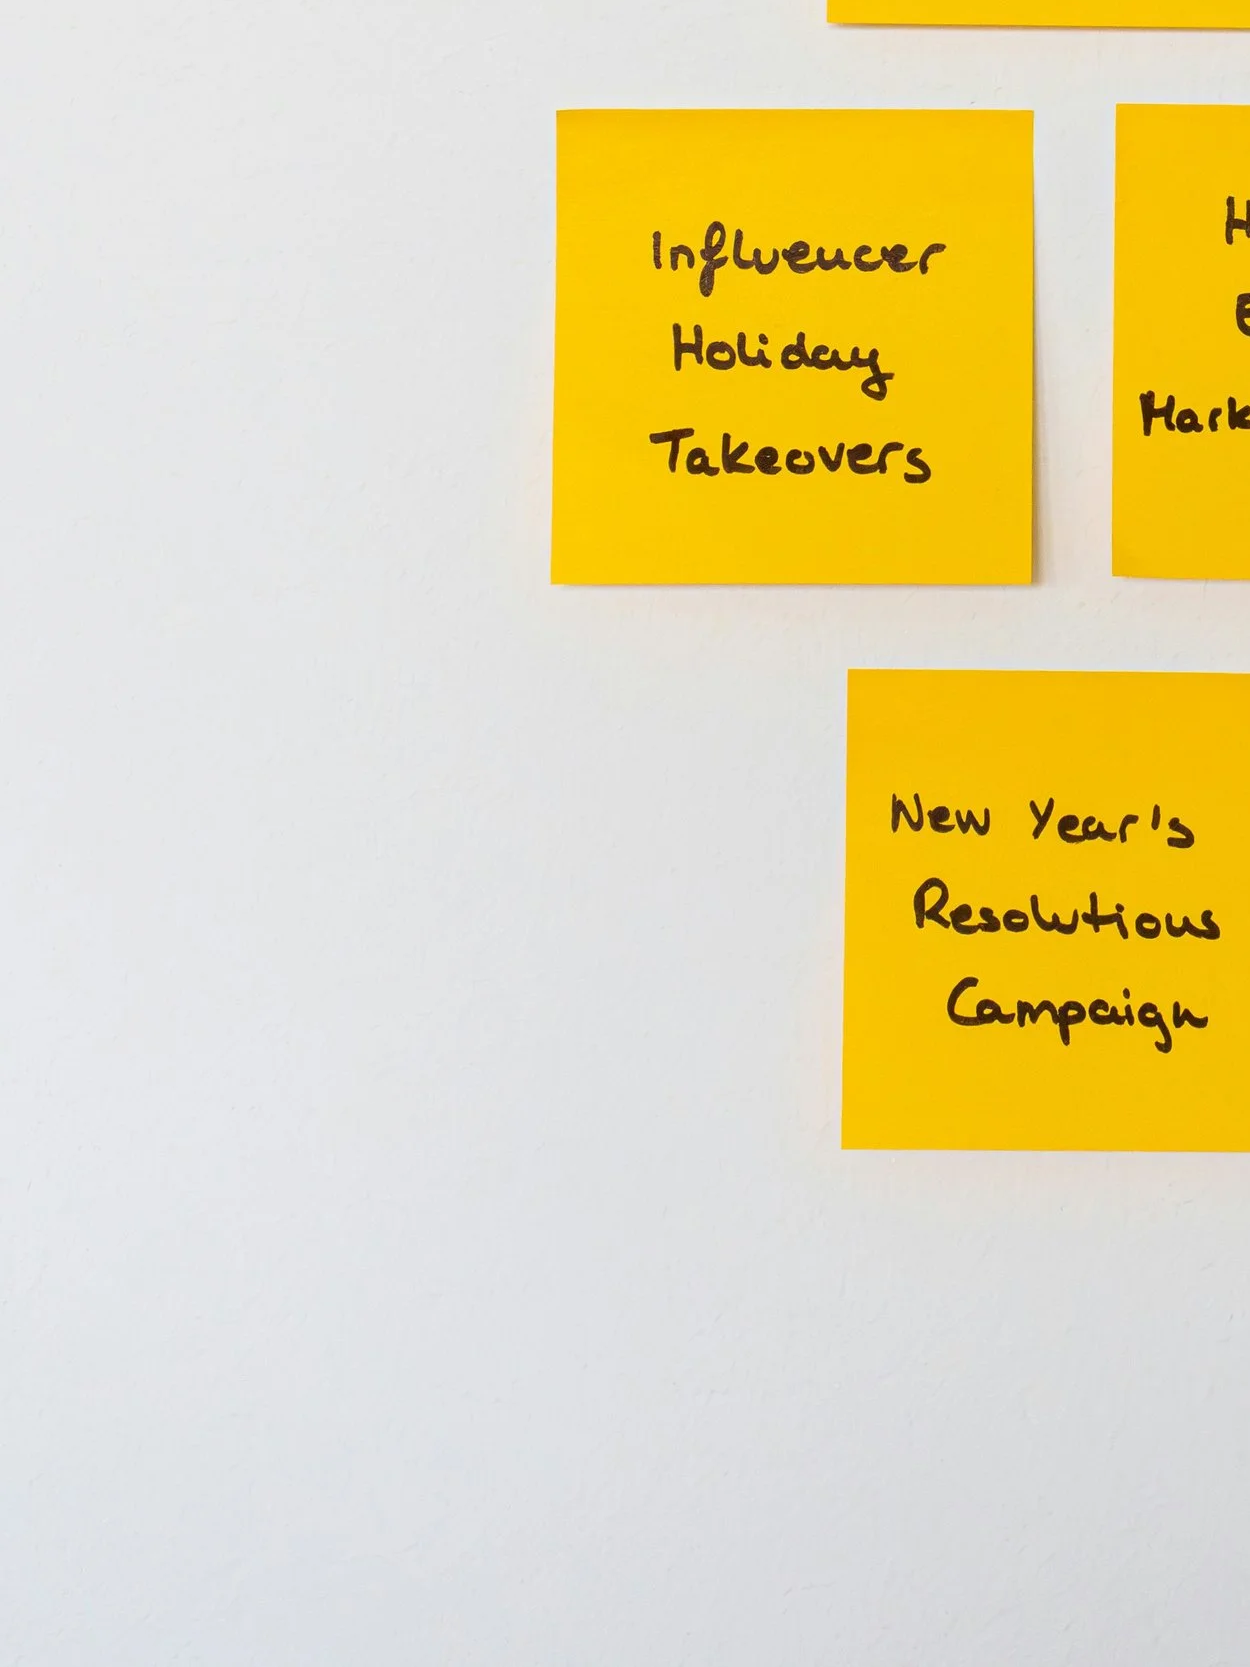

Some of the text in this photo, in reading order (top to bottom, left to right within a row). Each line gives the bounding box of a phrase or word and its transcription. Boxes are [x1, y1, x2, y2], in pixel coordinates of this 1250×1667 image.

[651, 220, 948, 299] Influencer
[671, 322, 896, 403] Holiday
[648, 426, 933, 485] Takeovers
[890, 791, 1196, 850] New Year's
[912, 876, 1222, 942] Resolutions
[945, 975, 1210, 1055] Campaign
